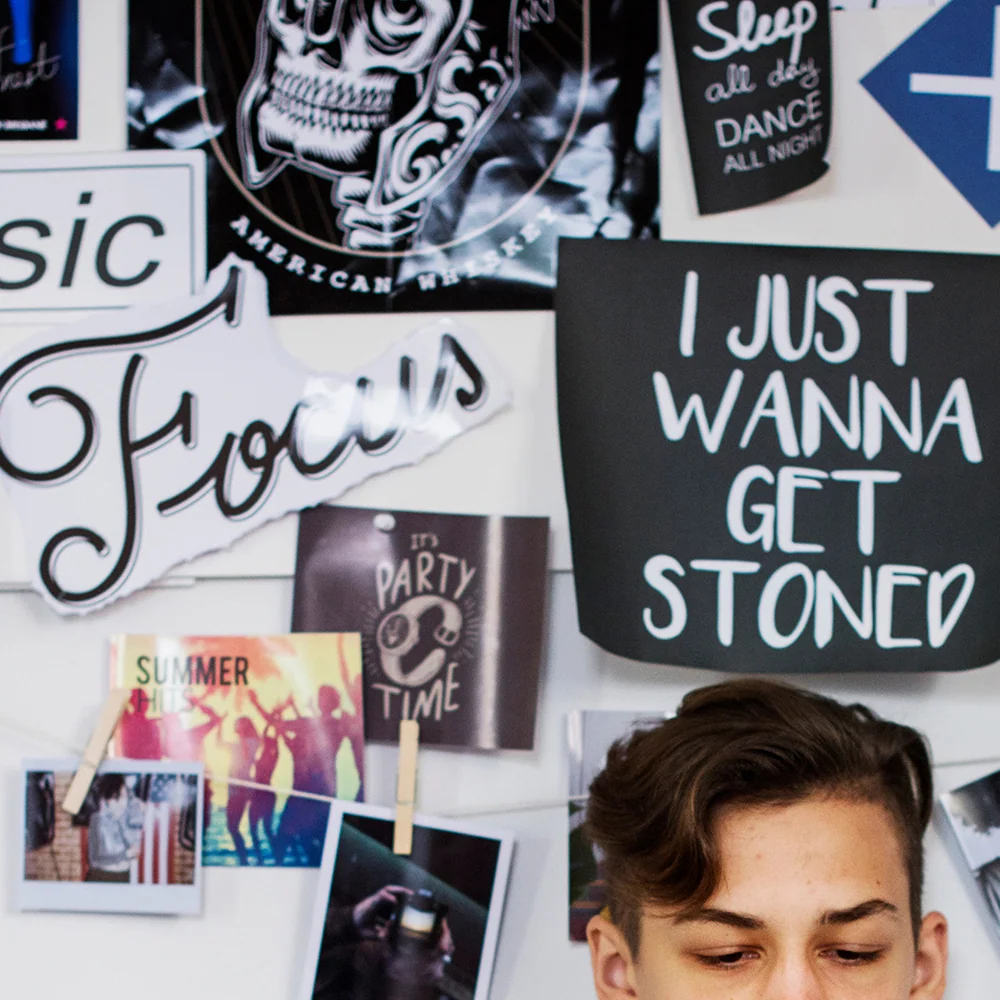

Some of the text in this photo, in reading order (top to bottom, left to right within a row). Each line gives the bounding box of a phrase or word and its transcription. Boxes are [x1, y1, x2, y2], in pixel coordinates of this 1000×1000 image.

[692, 0, 818, 65] Sleep
[704, 57, 822, 104] all day
[715, 90, 824, 148] DANCE
[723, 124, 825, 175] ALL NIGHT
[0, 190, 166, 290] sic
[229, 205, 560, 294] AMERICAN WHISKEY
[679, 270, 935, 366] I JUST
[0, 264, 487, 602] Focus
[652, 368, 983, 463] WANNA
[725, 464, 902, 557] GET
[376, 551, 478, 612] PARTY
[642, 553, 976, 649] STONED
[136, 655, 250, 686] SUMMER
[371, 661, 461, 722] TIME
